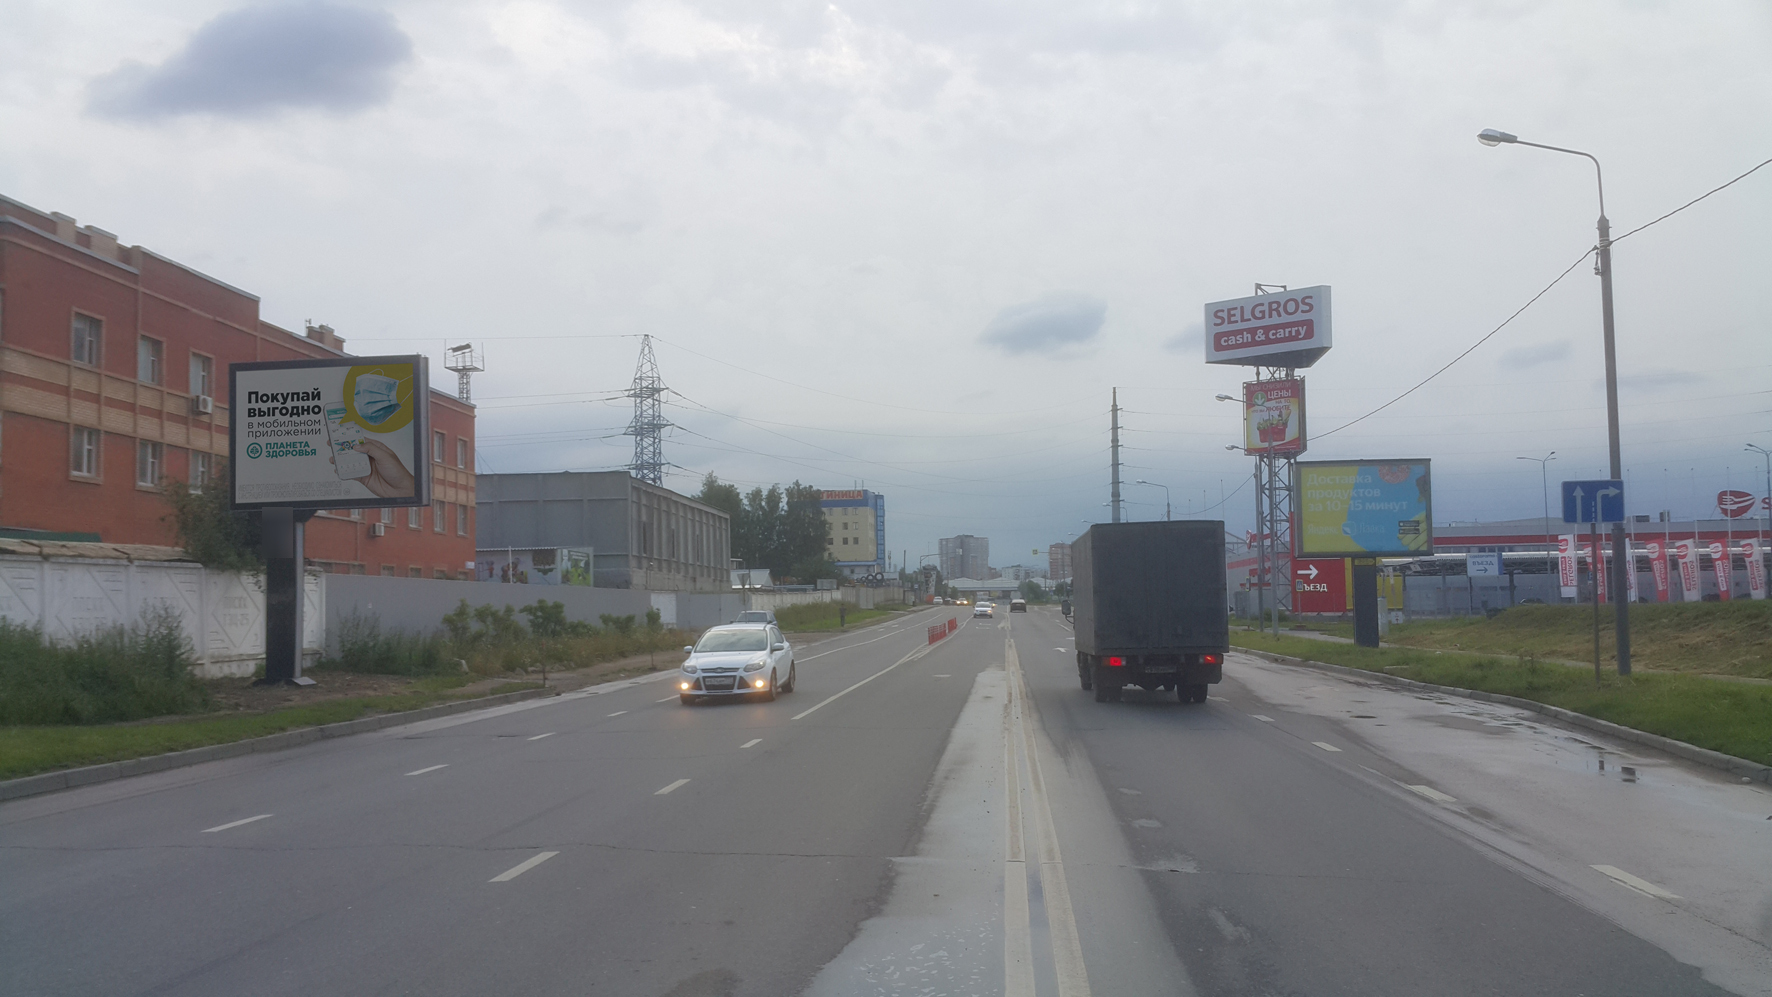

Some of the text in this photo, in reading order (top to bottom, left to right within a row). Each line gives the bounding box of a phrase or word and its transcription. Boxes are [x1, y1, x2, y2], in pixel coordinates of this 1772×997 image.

[1214, 296, 1314, 326] SELGROS
[1221, 325, 1306, 346] cash & carry
[248, 388, 321, 404] Покупай
[1268, 390, 1291, 399] ЦЕНЫ
[248, 404, 322, 418] выгодно
[1266, 404, 1291, 412] ЛЮБИТЕ
[258, 418, 321, 428] мобильном
[248, 428, 321, 439] приложении
[266, 441, 310, 450] ПЛАНЕТА
[266, 448, 316, 459] ЗДОРОВЬЯ
[1306, 474, 1372, 486] Доставка
[820, 490, 863, 499] ТИНИЦА
[1307, 488, 1381, 500] продуктов
[1308, 504, 1323, 512] за
[1366, 501, 1407, 512] минут
[1303, 583, 1327, 592] ЪЕЗД
